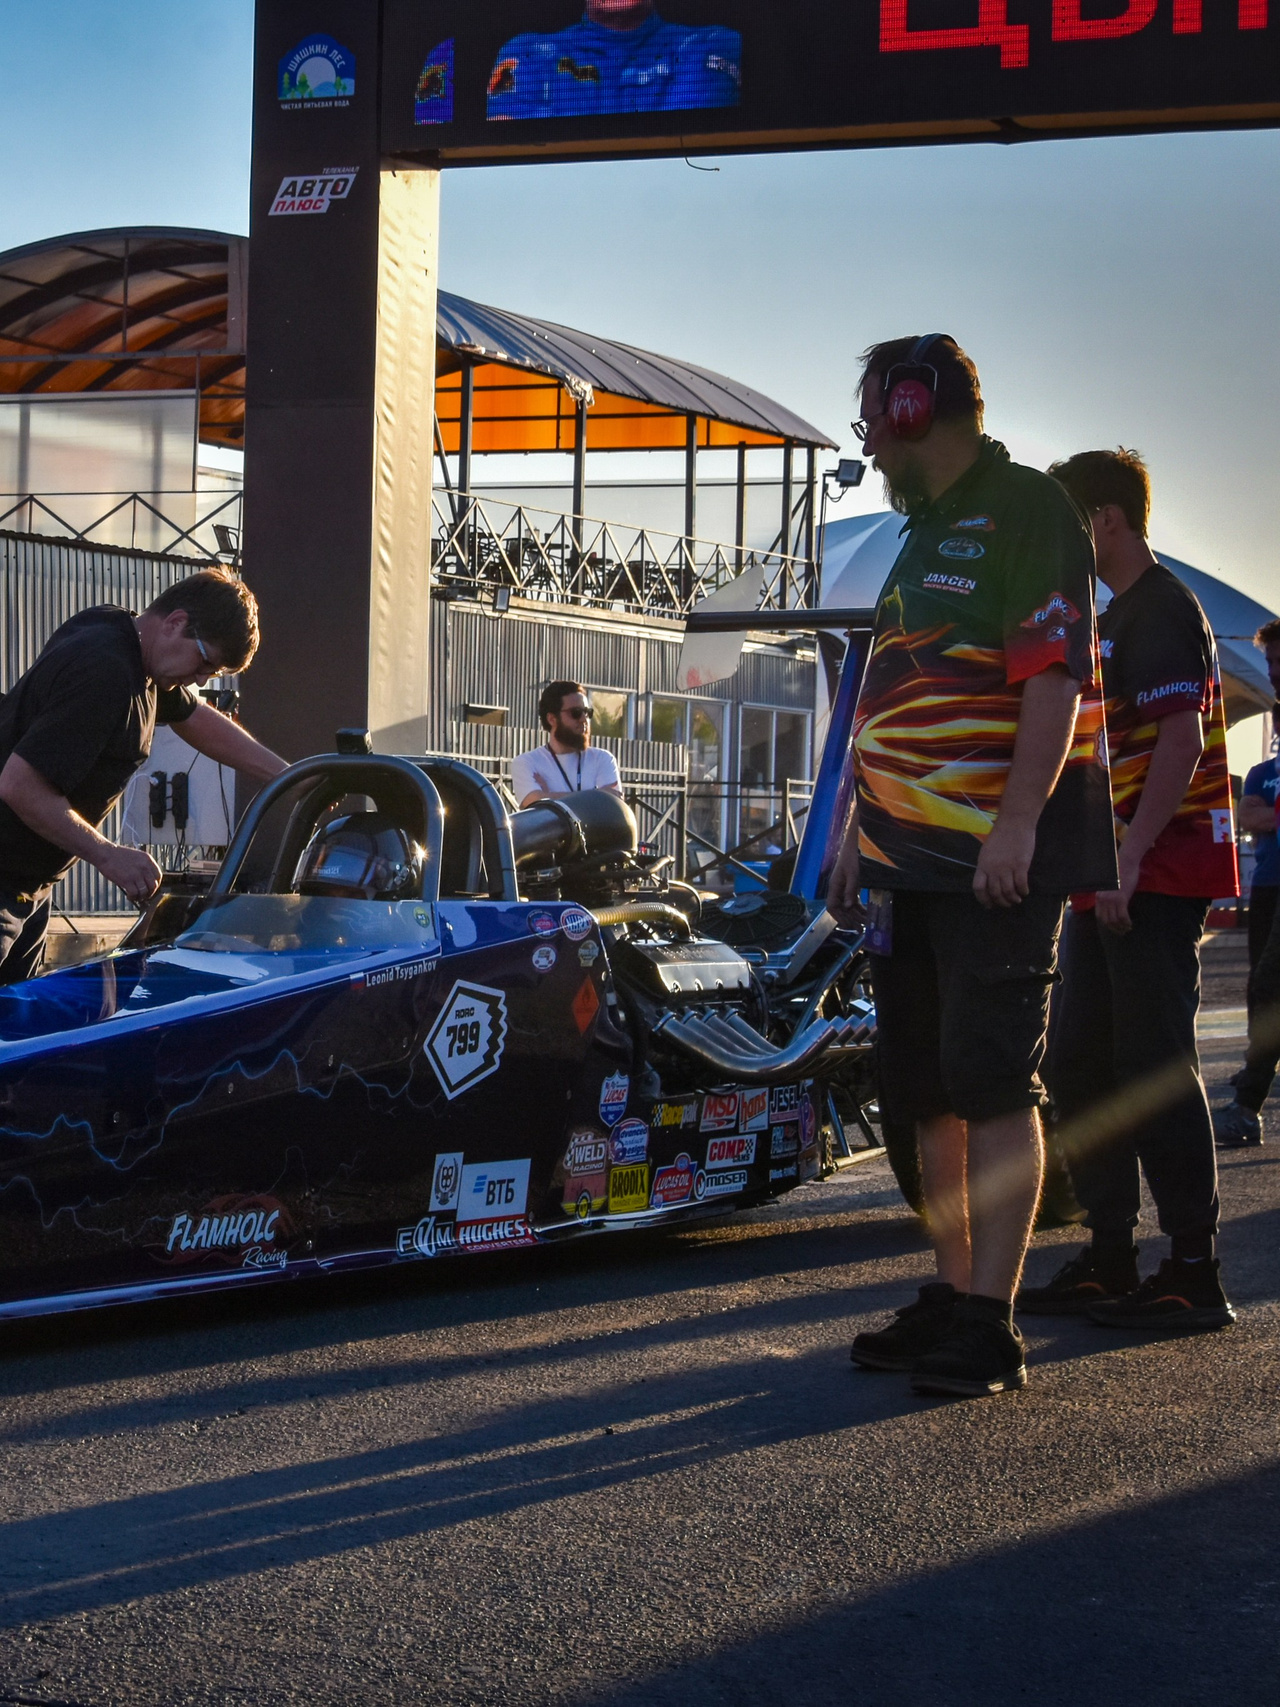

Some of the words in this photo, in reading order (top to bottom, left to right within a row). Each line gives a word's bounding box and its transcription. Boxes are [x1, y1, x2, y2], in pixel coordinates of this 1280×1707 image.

[287, 44, 329, 72] ШИШКИН
[328, 49, 346, 69] ЛЕС
[281, 177, 349, 198] АВТО
[274, 198, 325, 212] ПЛЮС
[1137, 682, 1200, 706] FLAMHOLC
[366, 967, 394, 987] Leonid
[395, 959, 437, 983] Tsygankov
[446, 1020, 480, 1058] 799
[604, 1089, 627, 1103] LUCAS
[703, 1093, 738, 1120] MSD
[741, 1091, 767, 1131] hans
[575, 1143, 605, 1163] WELD
[709, 1139, 746, 1162] COMP
[573, 1162, 604, 1172] RACING
[486, 1178, 516, 1206] ВТБ
[612, 1167, 646, 1199] BRODIX
[656, 1177, 678, 1191] LUCAS
[679, 1173, 690, 1186] OIL
[166, 1209, 279, 1251] FLAMHOLC
[459, 1218, 526, 1245] HUGHES
[467, 1238, 533, 1251] CONVERTERS
[241, 1246, 288, 1269] Racing
